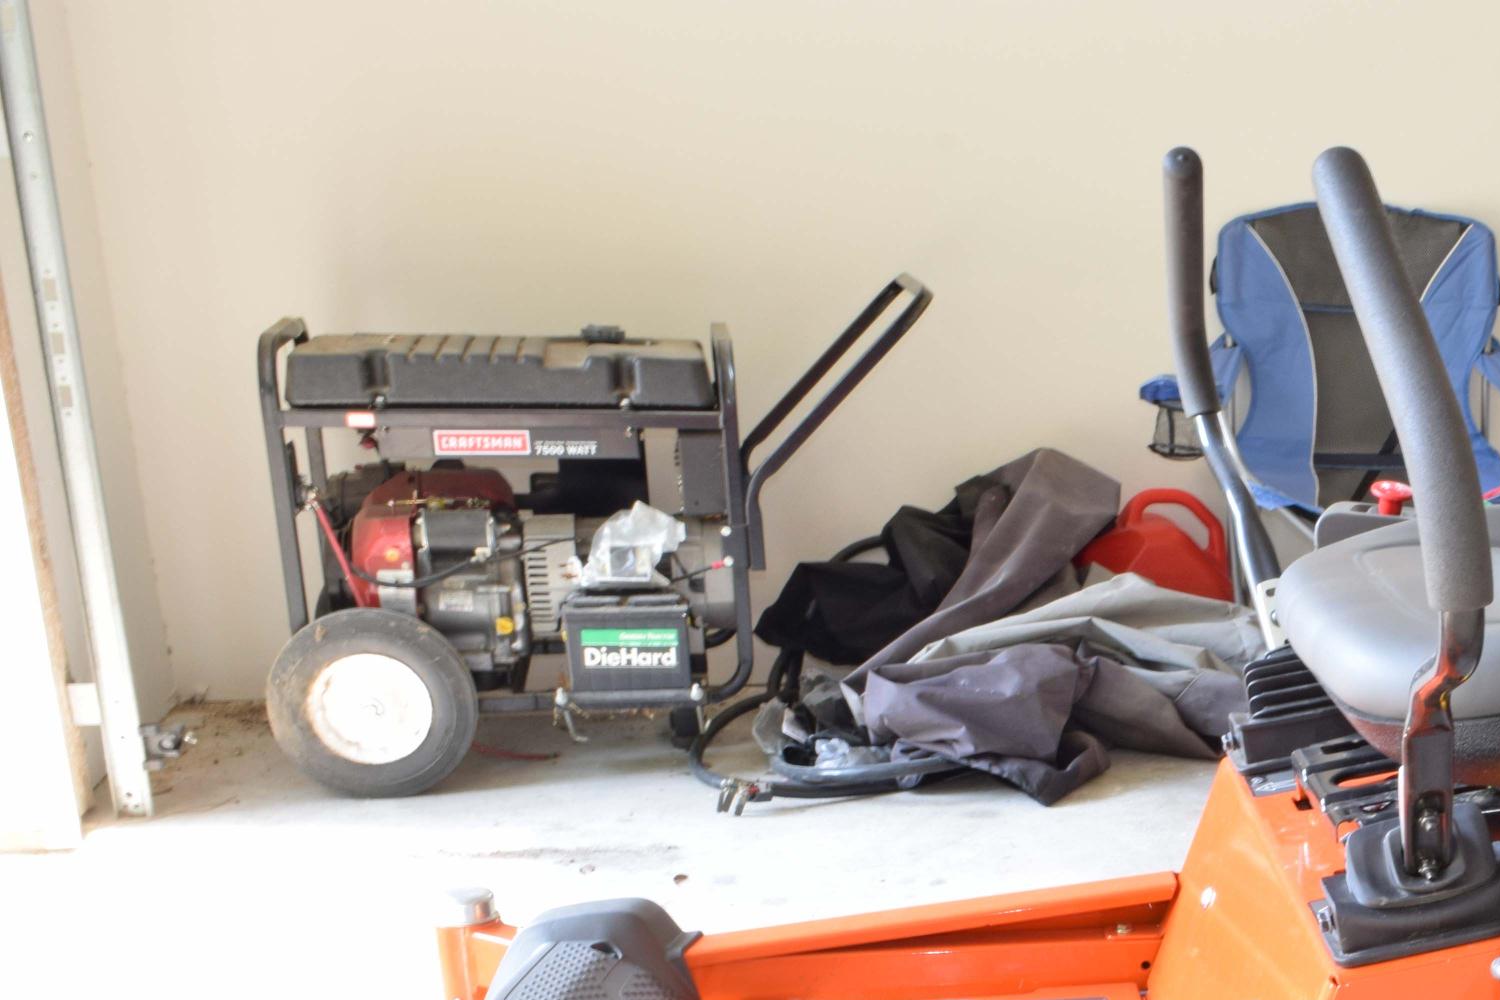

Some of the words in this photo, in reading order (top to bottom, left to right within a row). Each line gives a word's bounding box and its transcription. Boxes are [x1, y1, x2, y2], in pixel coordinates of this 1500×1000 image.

[440, 435, 523, 449] CRAFTSMAN
[534, 445, 565, 456] 7500
[566, 445, 598, 456] WATT
[583, 646, 677, 667] DieHard
